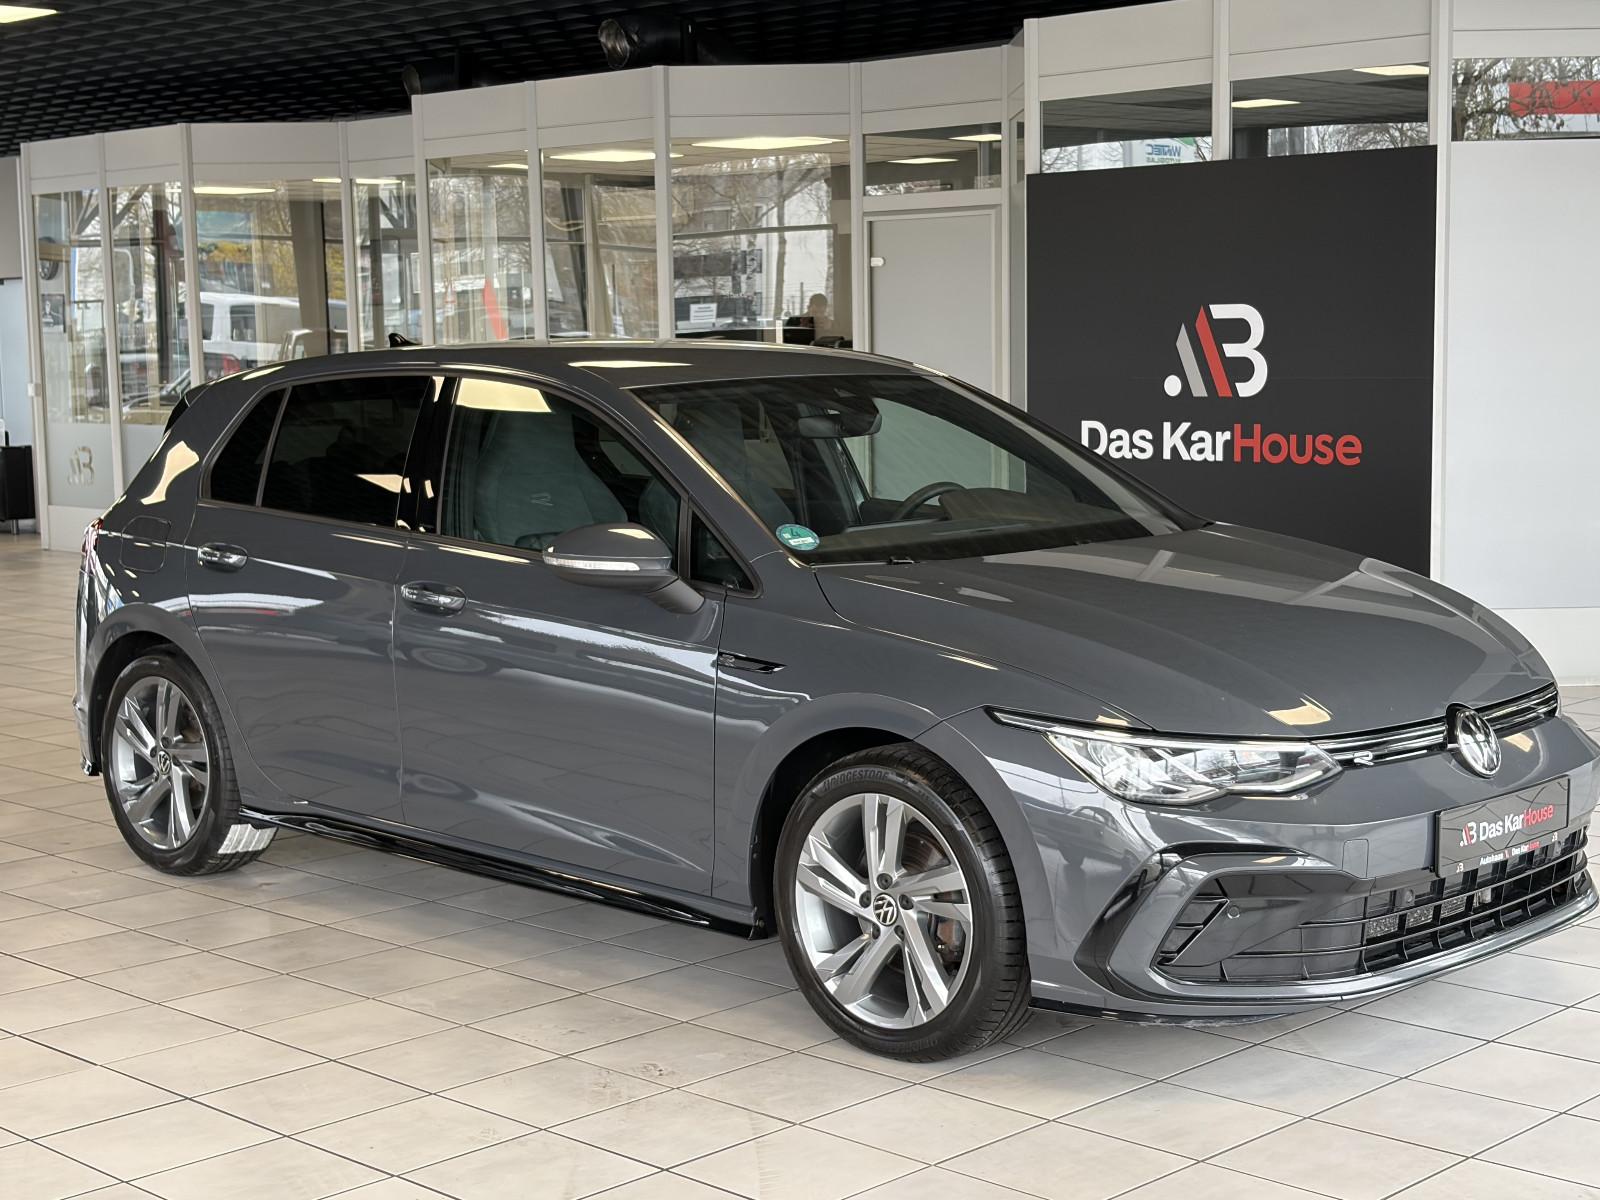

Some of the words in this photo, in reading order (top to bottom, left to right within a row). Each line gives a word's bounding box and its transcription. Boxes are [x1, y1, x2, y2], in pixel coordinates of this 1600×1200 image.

[1081, 420, 1154, 460] Das
[1163, 421, 1363, 467] KarHouse
[1479, 821, 1503, 841] Das
[1504, 804, 1555, 834] KarHouse
